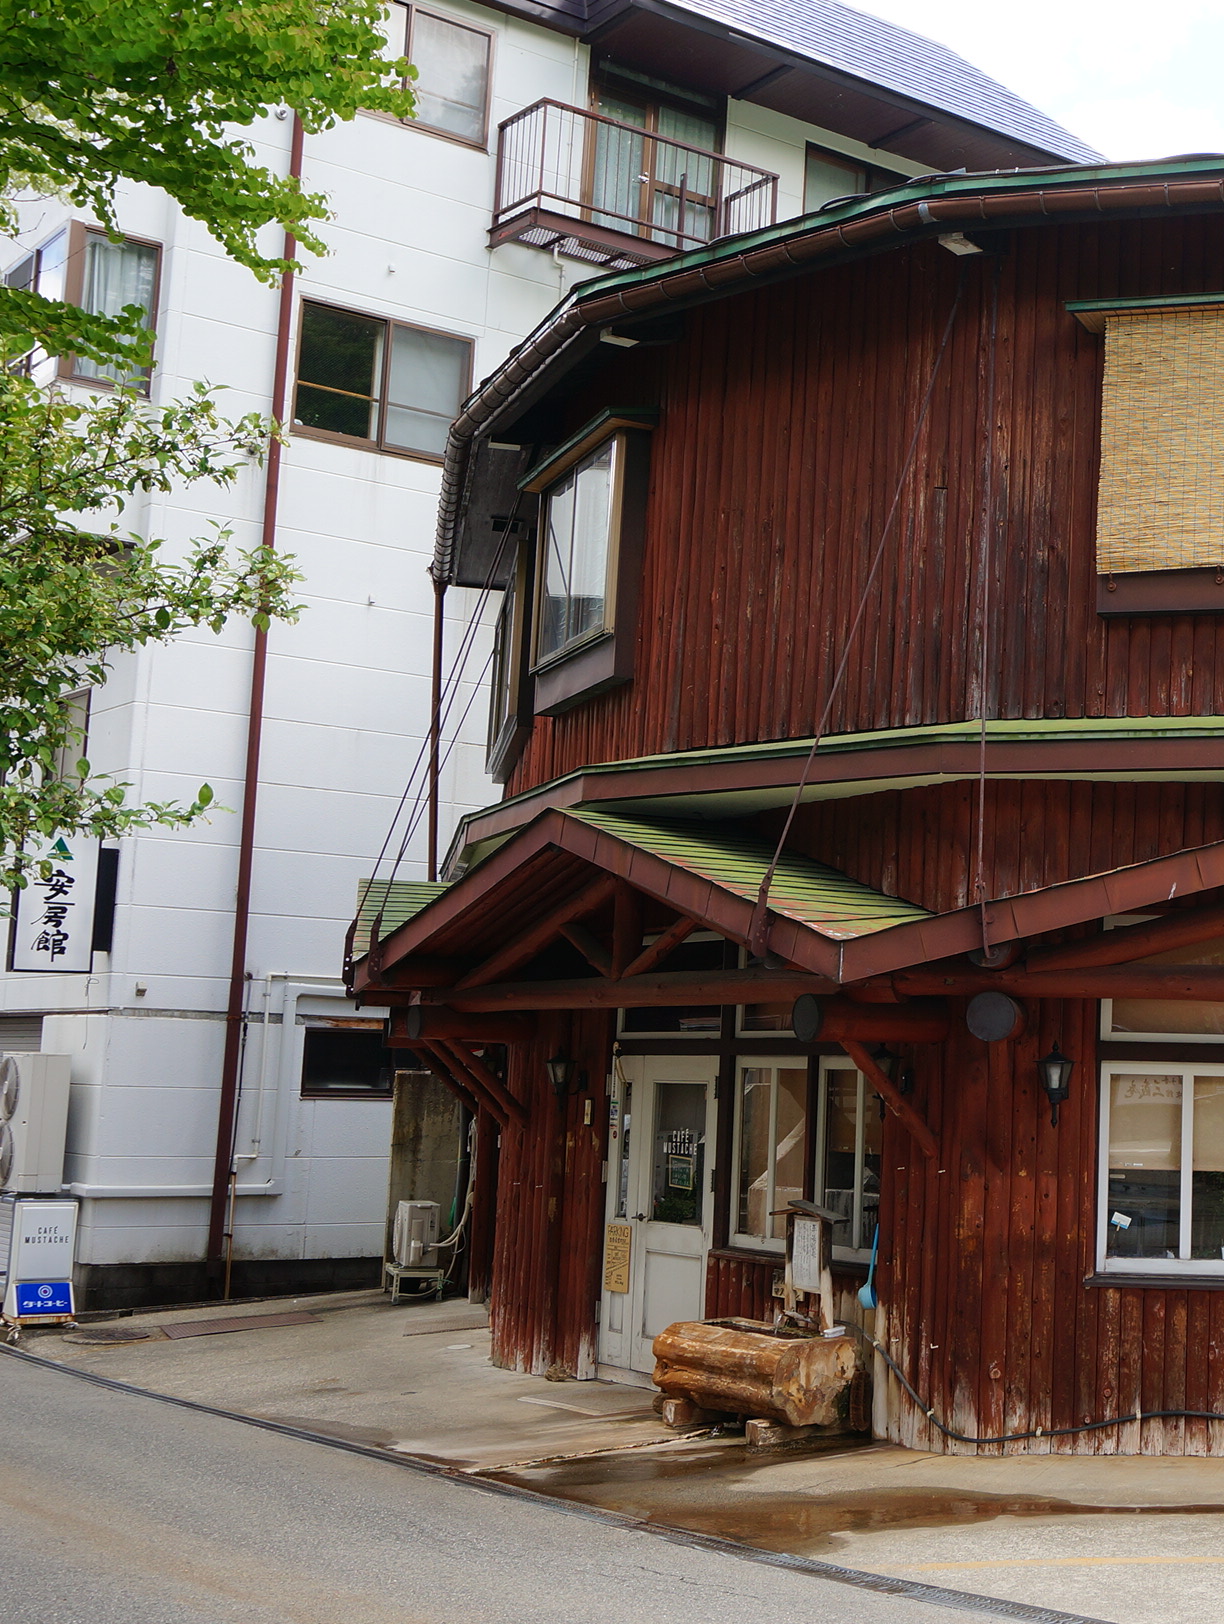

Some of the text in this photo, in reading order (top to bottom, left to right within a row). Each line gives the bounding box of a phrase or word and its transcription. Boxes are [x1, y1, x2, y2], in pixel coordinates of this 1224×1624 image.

[30, 868, 75, 962] 安房館
[672, 1128, 689, 1142] CAFÉ
[663, 1141, 698, 1156] MUSTACHE
[38, 1226, 58, 1235] CAFÉ
[24, 1235, 70, 1244] MUSTACHE
